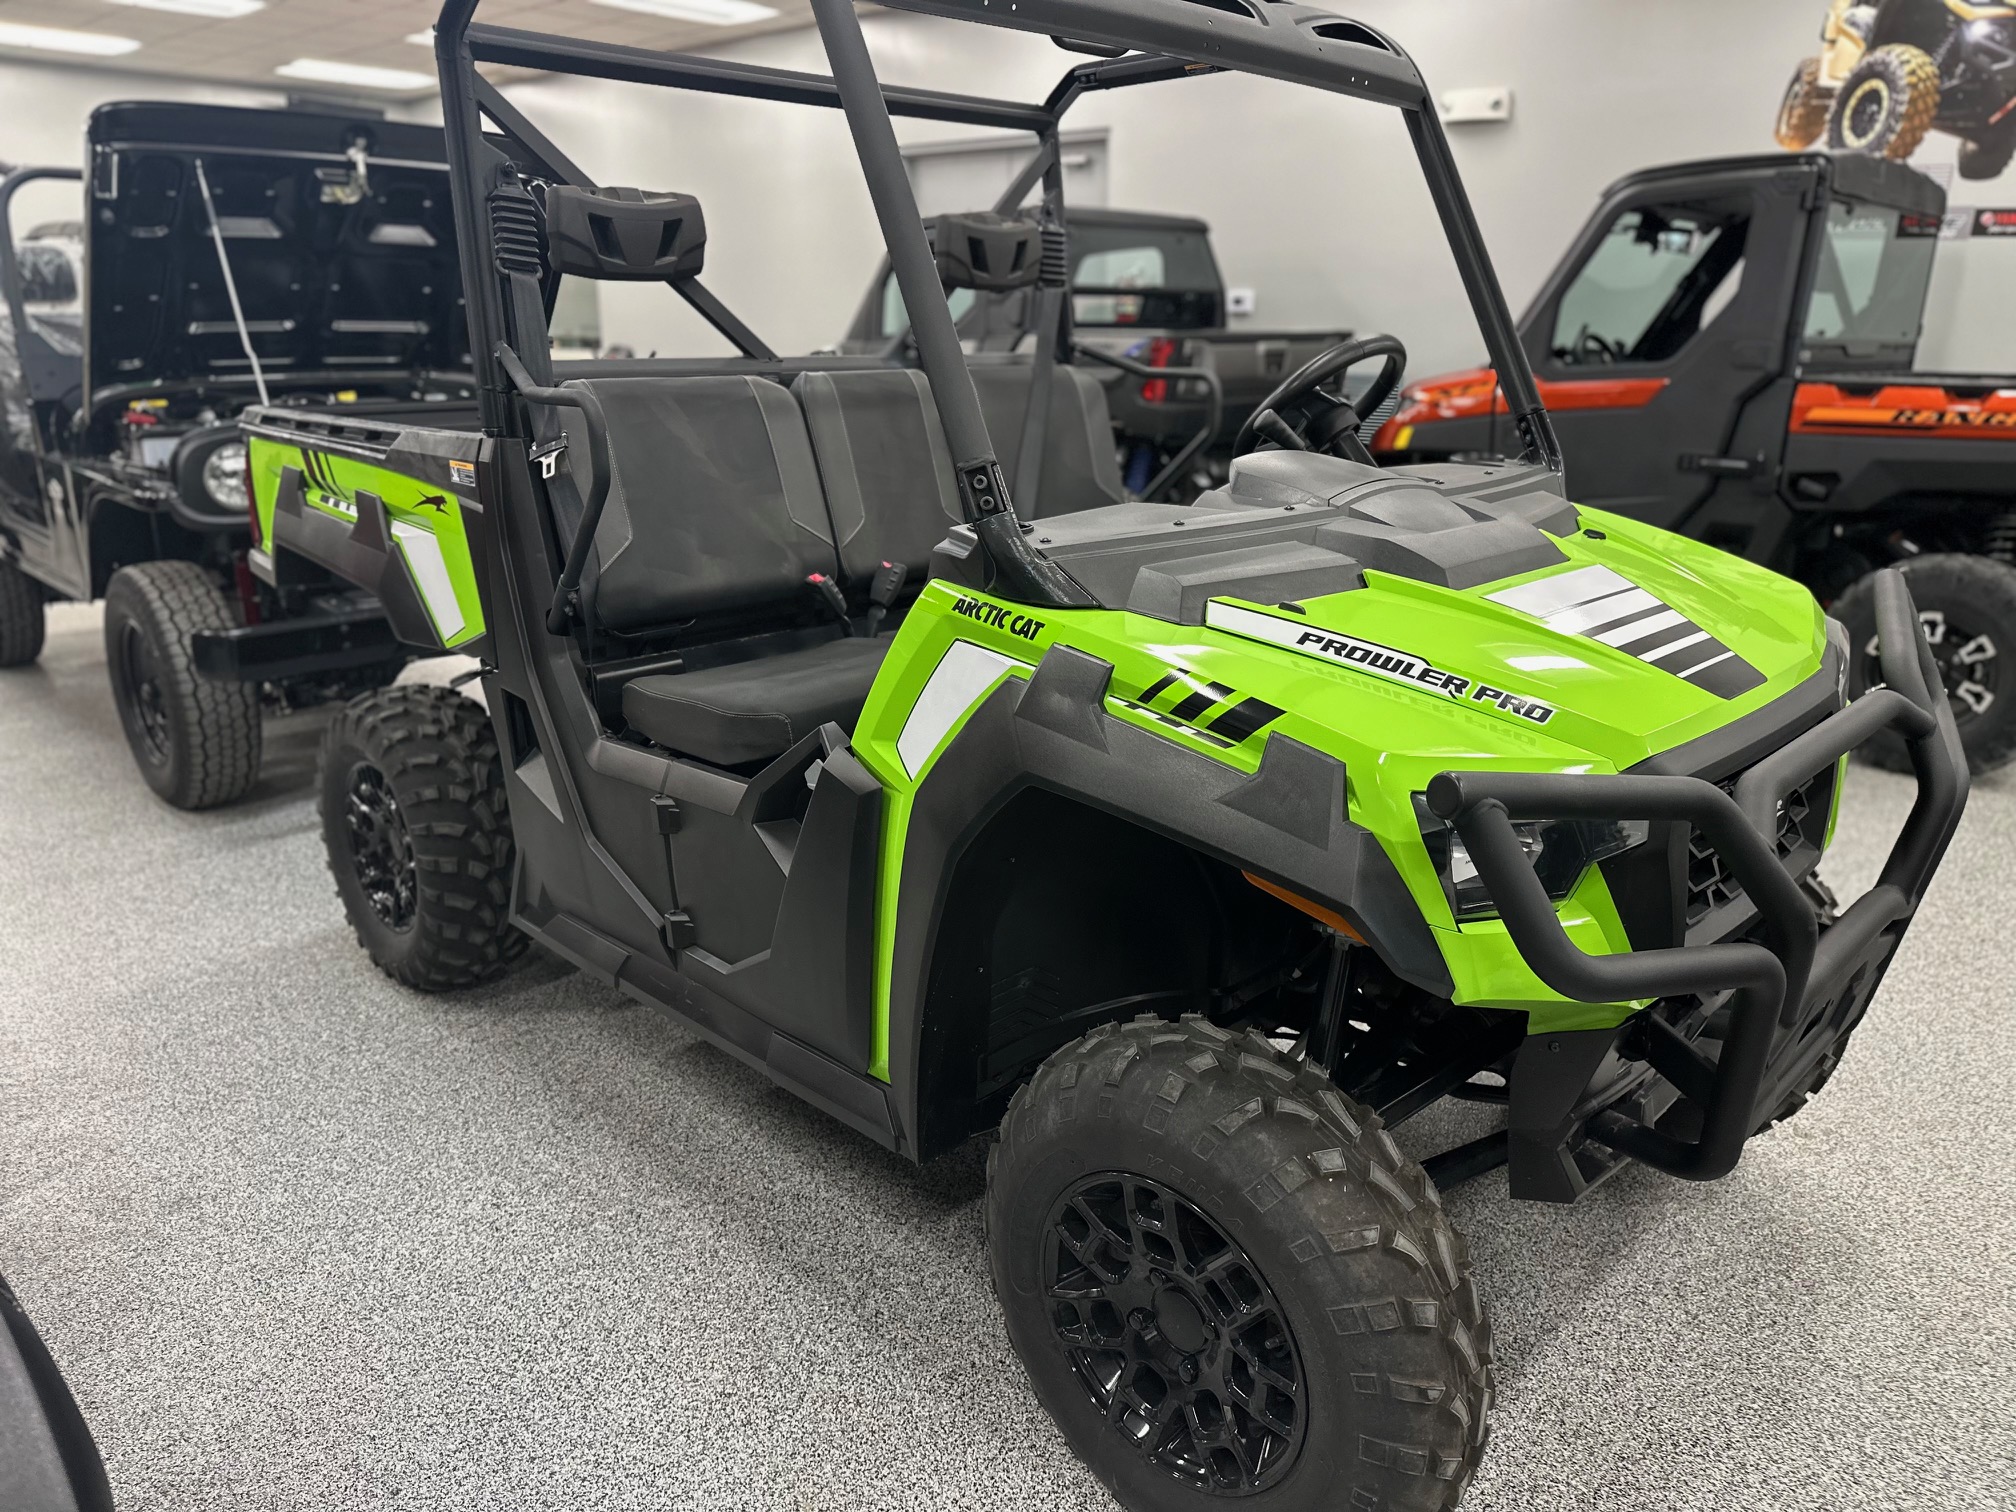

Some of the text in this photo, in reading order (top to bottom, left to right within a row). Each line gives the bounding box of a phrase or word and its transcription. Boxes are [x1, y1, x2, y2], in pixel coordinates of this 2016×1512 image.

[951, 594, 1046, 641] ARCTIC CAT
[1296, 631, 1554, 724] PROWLER PRO
